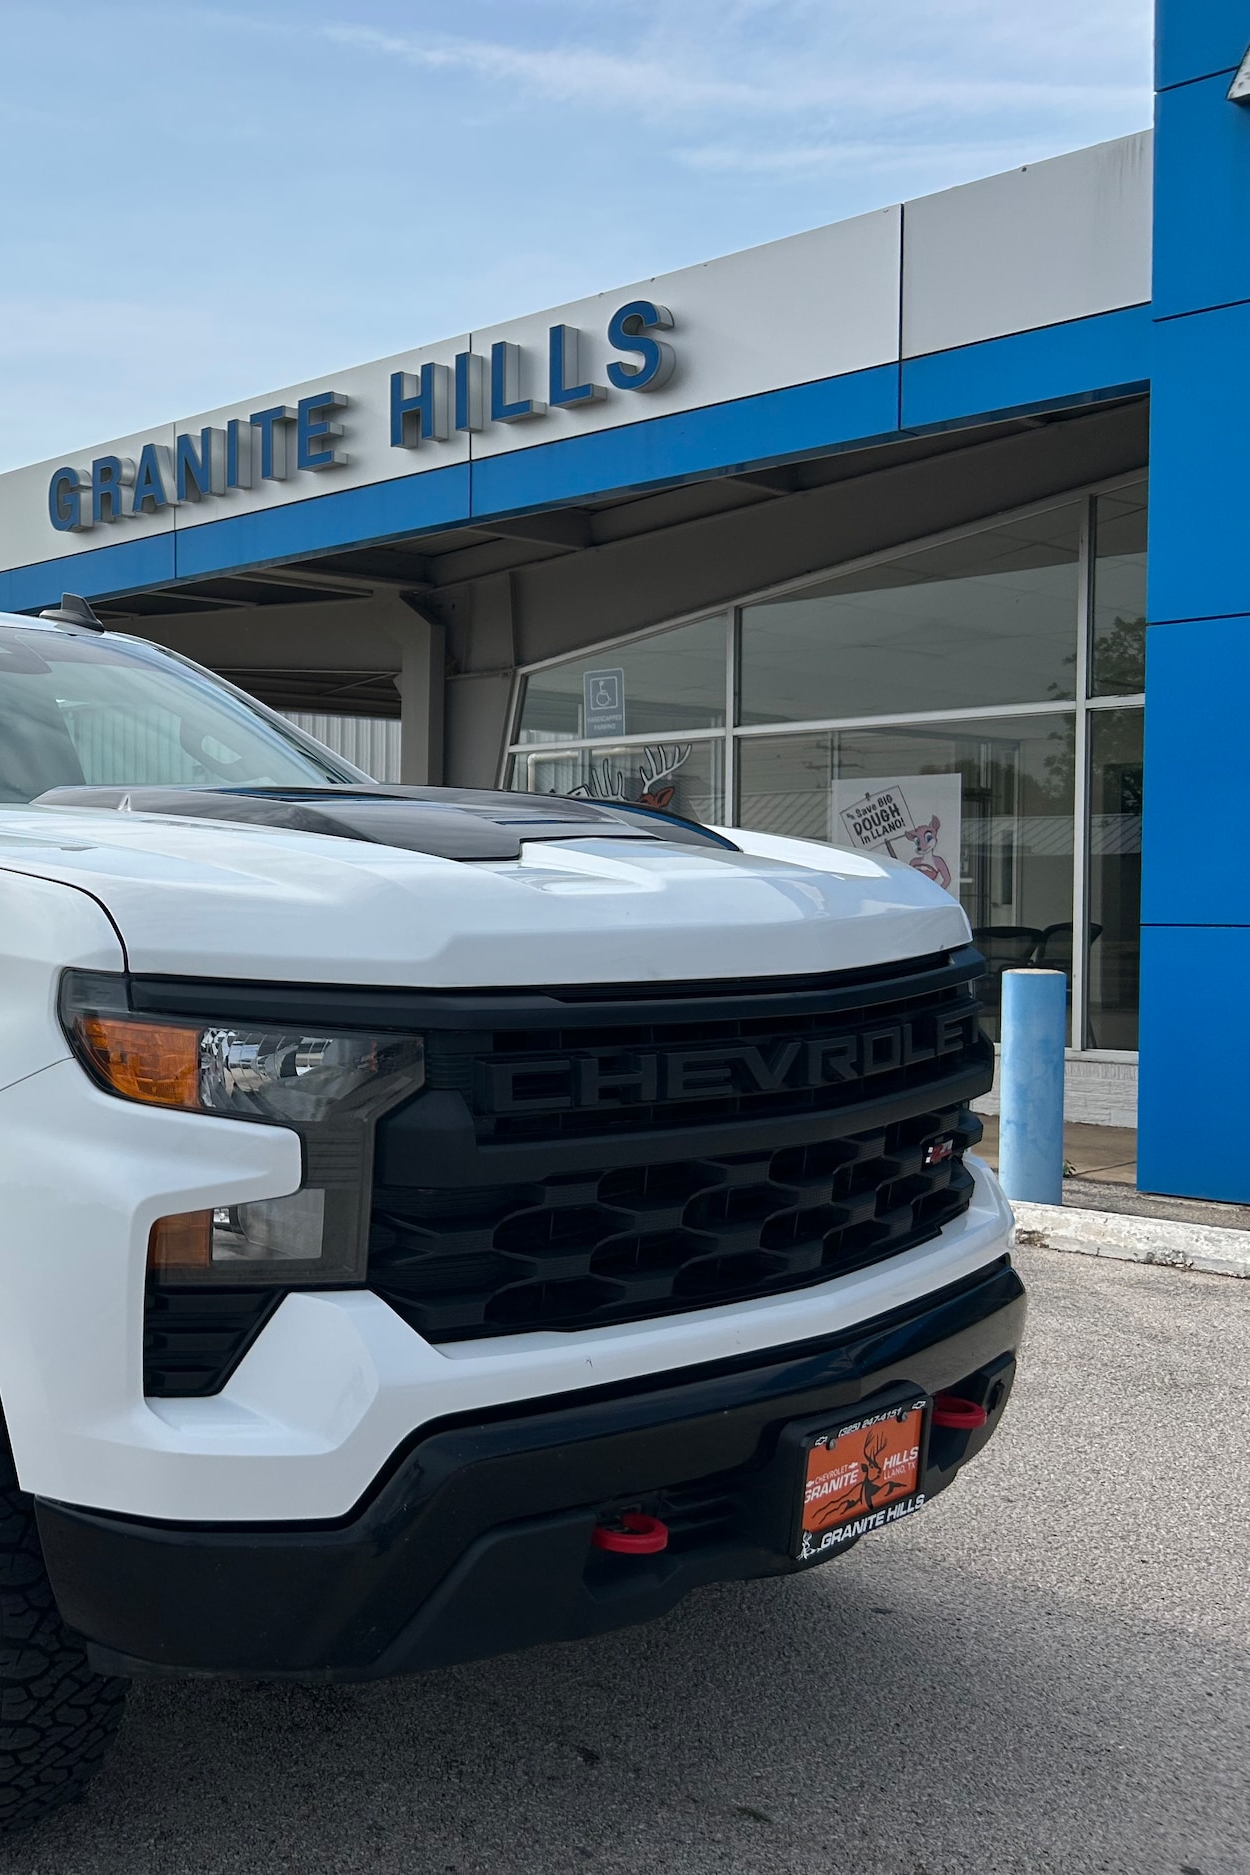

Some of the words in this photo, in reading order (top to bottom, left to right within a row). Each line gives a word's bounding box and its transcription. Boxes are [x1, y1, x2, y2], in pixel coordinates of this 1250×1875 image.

[48, 391, 348, 532] GRANITE
[390, 300, 675, 449] HILLS
[853, 803, 901, 836] DOUGH
[855, 803, 877, 818] Save
[860, 834, 871, 845] in
[870, 818, 906, 839] LLANO!
[475, 1001, 984, 1114] CHEVROLET
[838, 1421, 861, 1438] (325)
[861, 1407, 903, 1429] 247-4151
[883, 1446, 919, 1471] HILLS
[907, 1460, 917, 1472] TX
[814, 1464, 849, 1485] CHEVROLET
[821, 1510, 887, 1549] GRANITE
[886, 1493, 926, 1522] HILLS
